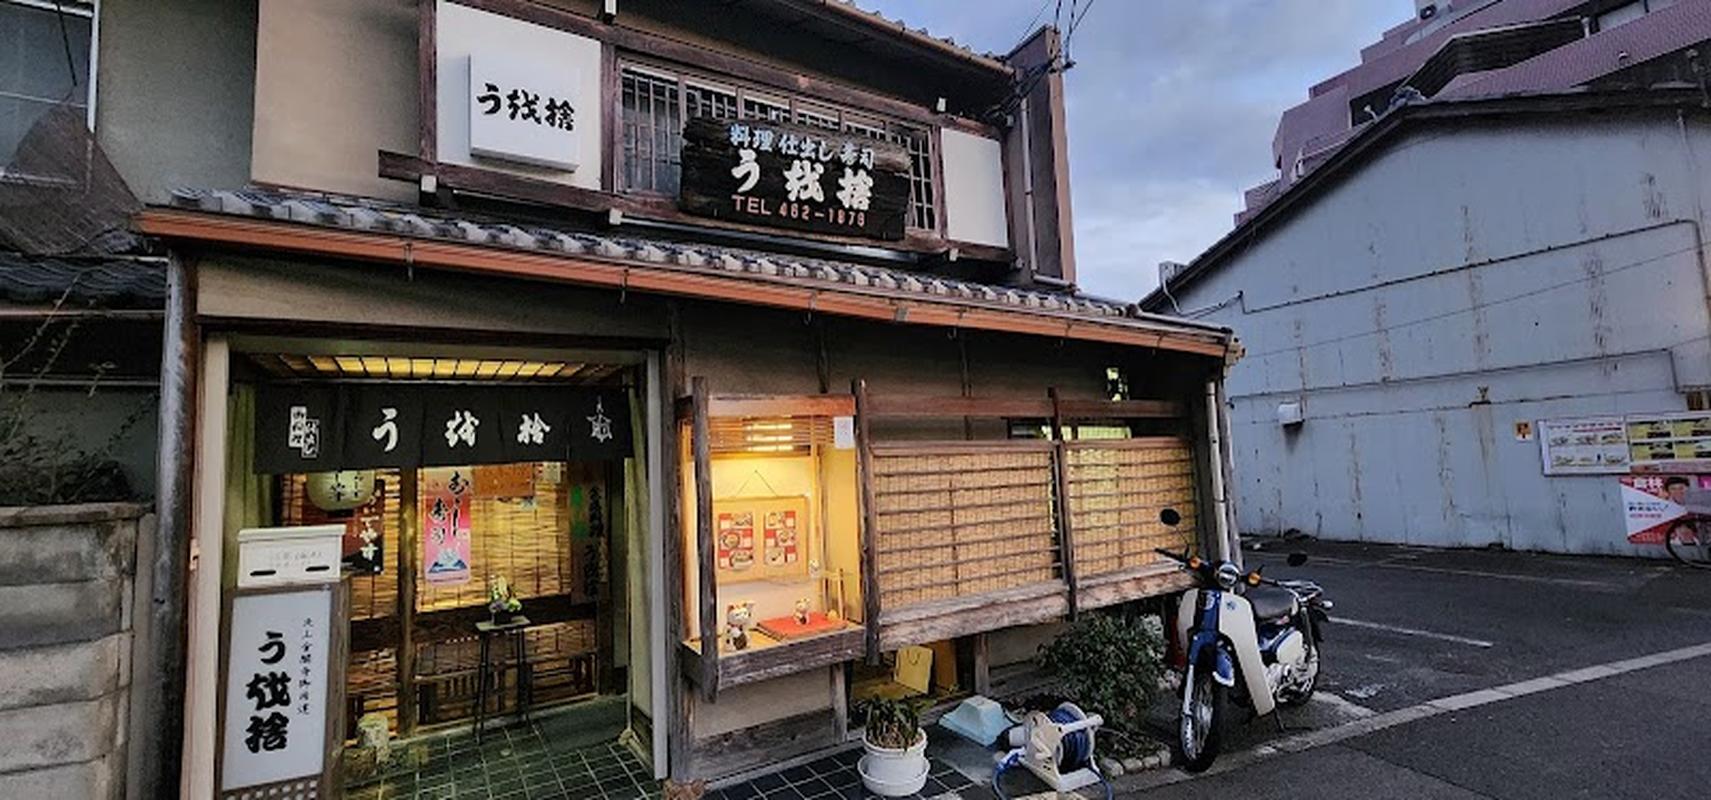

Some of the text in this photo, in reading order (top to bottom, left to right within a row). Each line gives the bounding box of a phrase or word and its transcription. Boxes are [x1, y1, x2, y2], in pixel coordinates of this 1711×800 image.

[730, 124, 874, 170] 料理 仕出し 寿司
[731, 194, 772, 215] TEL
